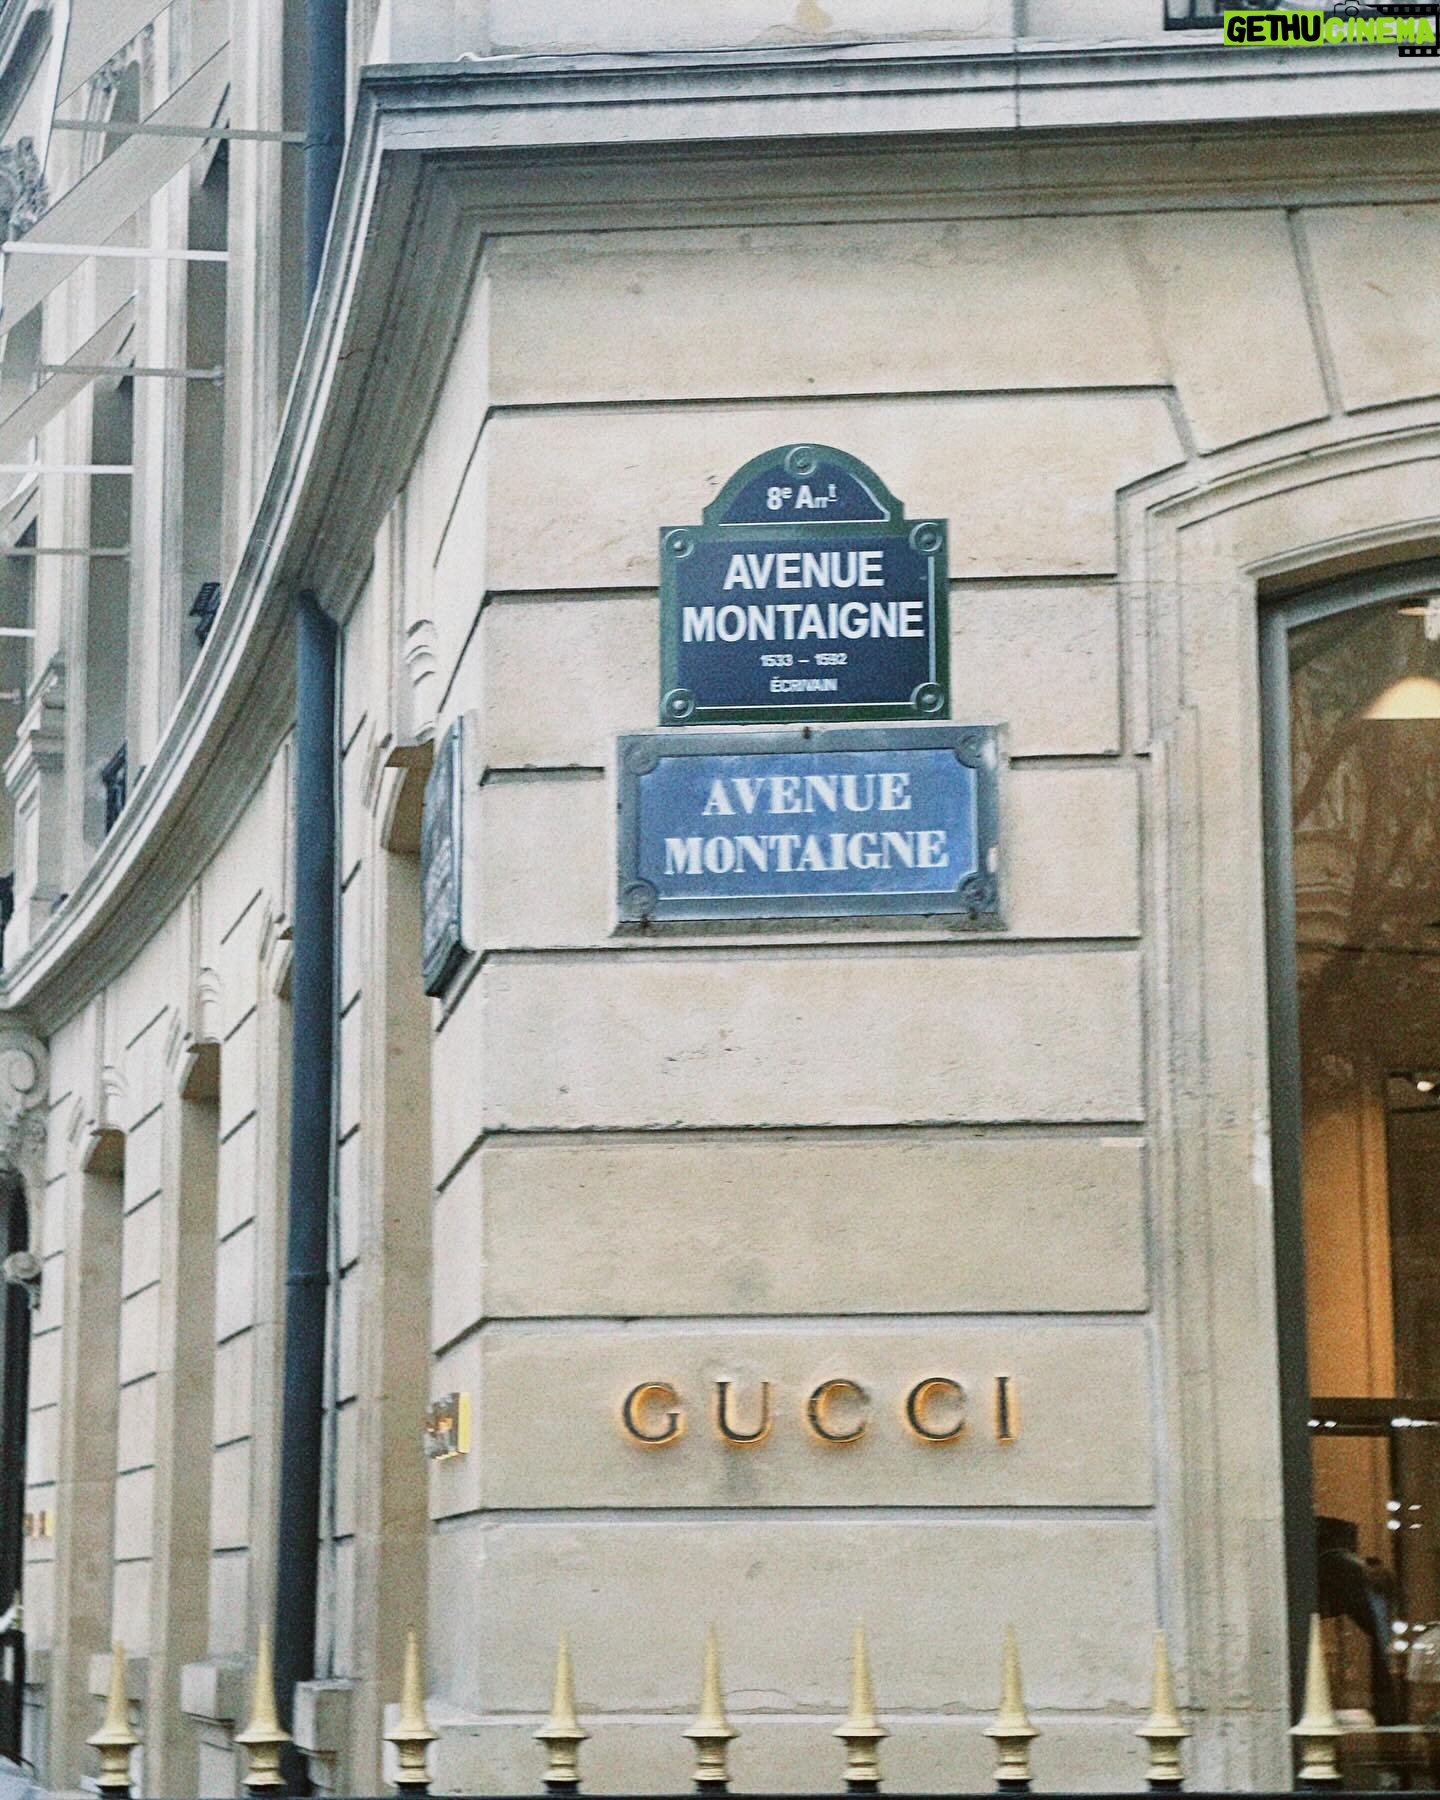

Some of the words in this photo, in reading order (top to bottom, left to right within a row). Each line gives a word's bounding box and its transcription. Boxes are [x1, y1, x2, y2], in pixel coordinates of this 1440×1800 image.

[723, 551, 885, 590] AVENUE
[682, 601, 924, 642] MONTAIGNE
[702, 773, 912, 816] AVENUE
[664, 831, 949, 875] MONTAIGNE
[623, 1376, 1018, 1444] GUCCI
